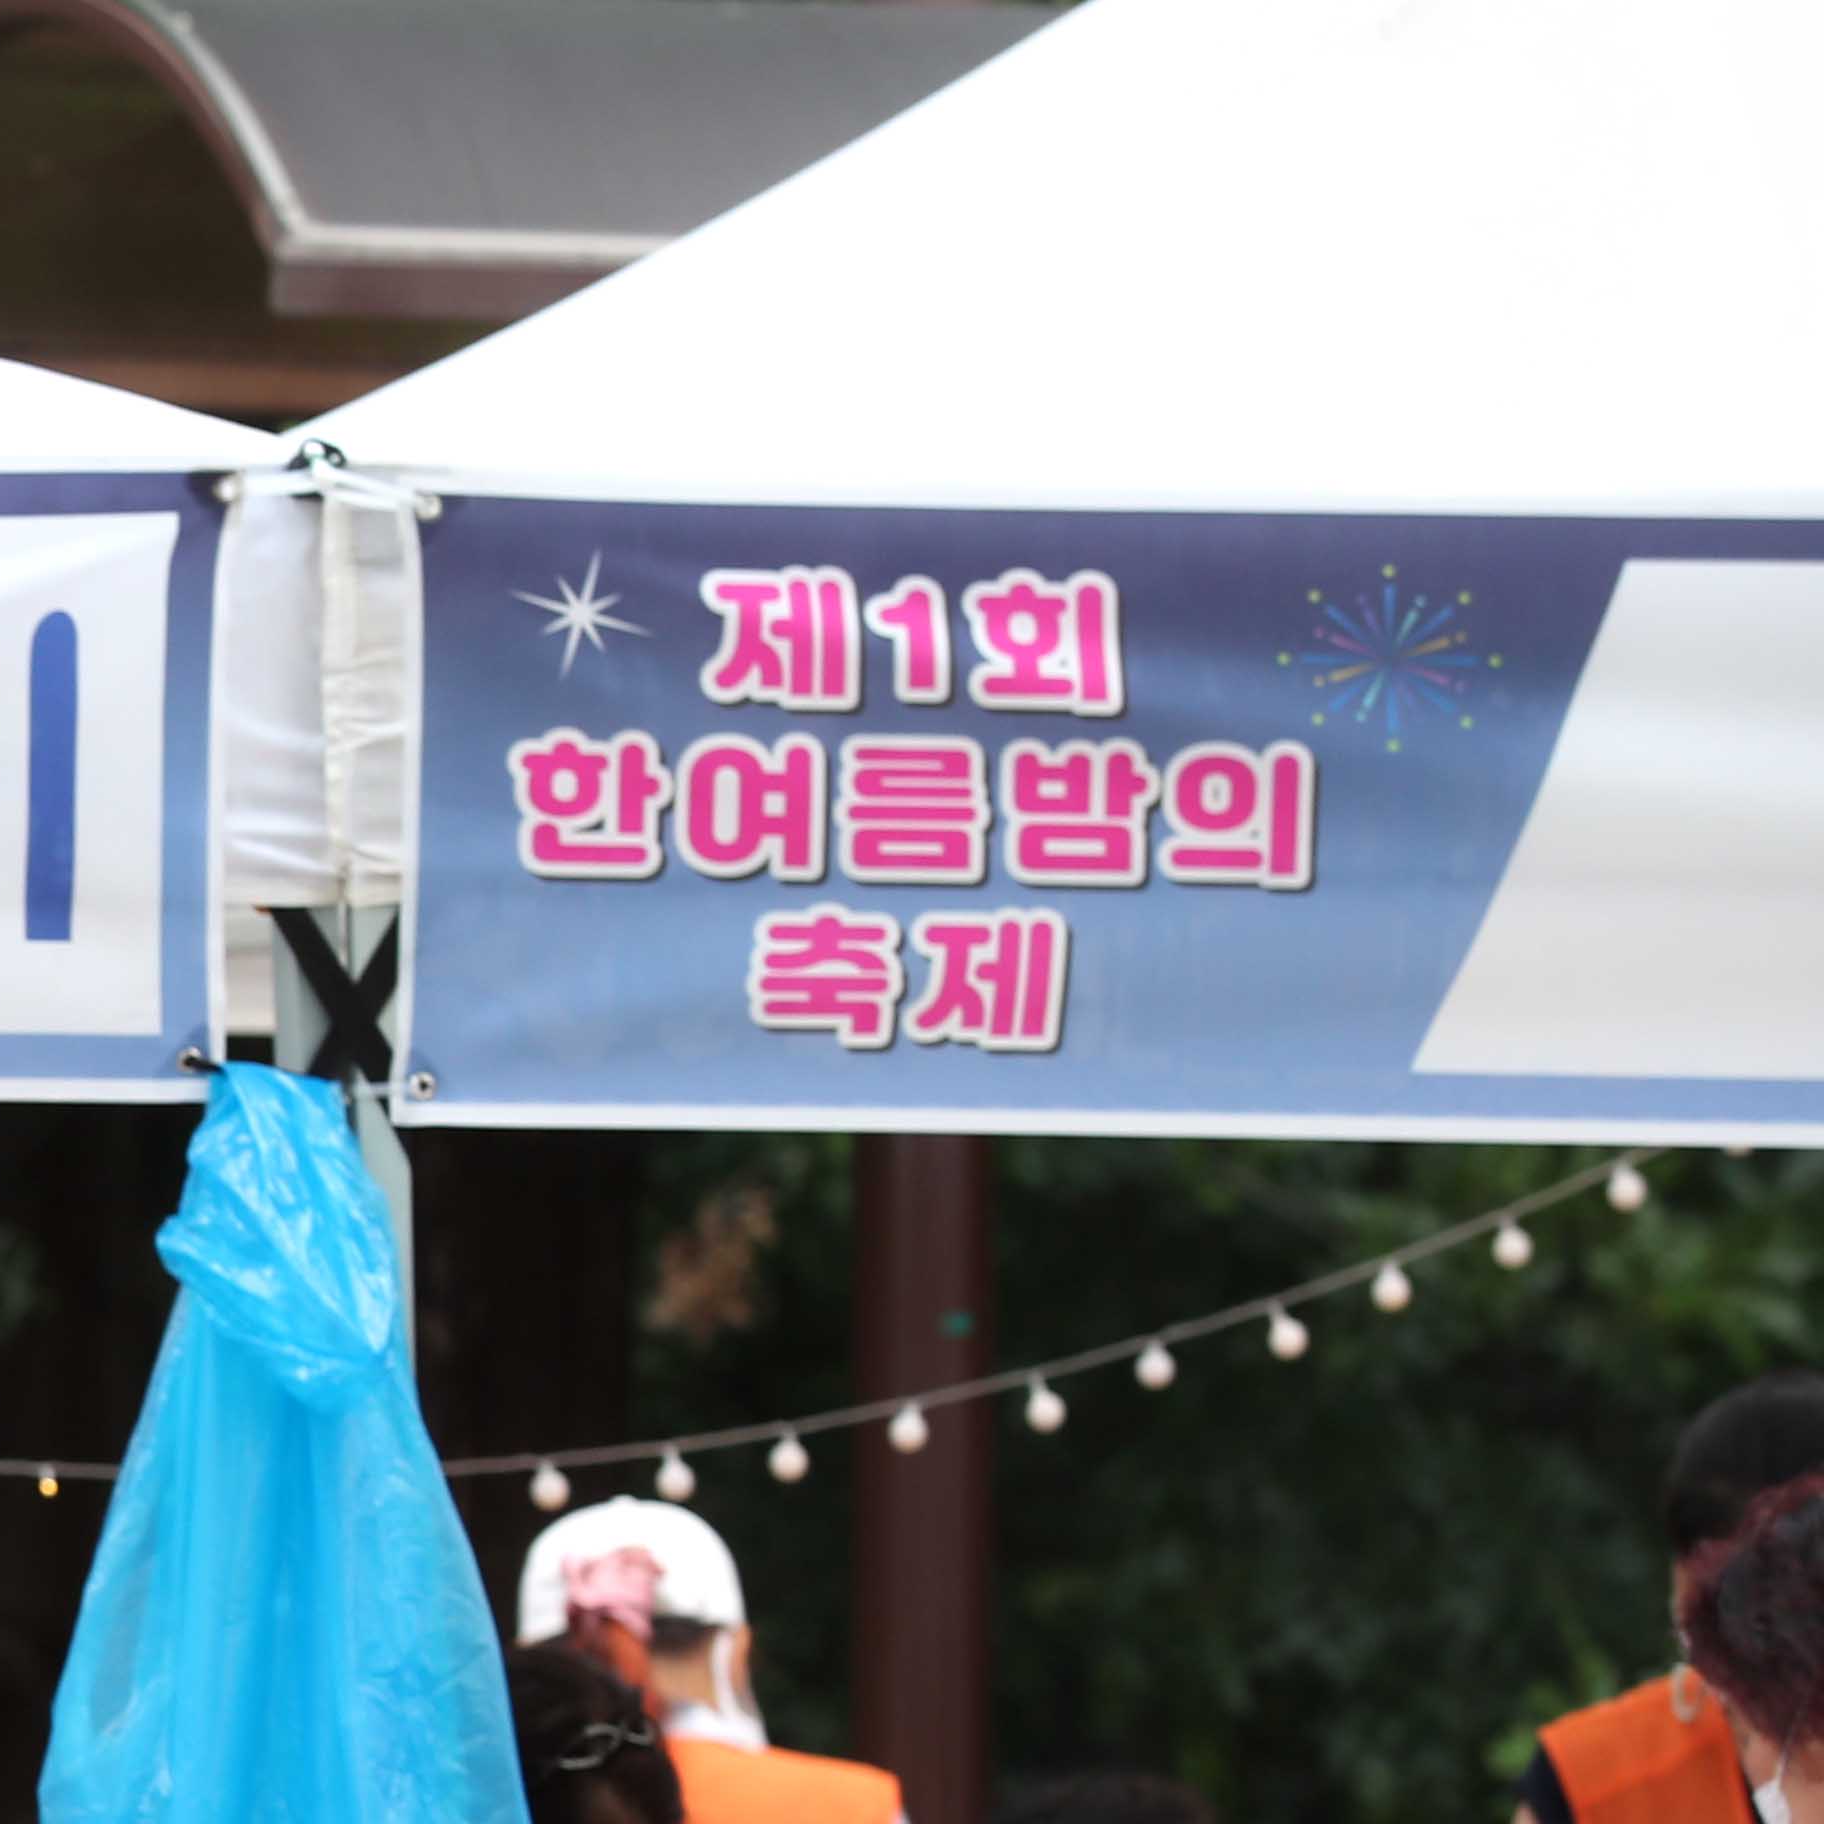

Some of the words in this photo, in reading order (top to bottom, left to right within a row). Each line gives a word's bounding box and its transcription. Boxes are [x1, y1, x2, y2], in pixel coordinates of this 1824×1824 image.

[704, 568, 1122, 713] 제1회
[510, 730, 1314, 886] 한여름밤의
[751, 906, 1065, 1049] 축제
